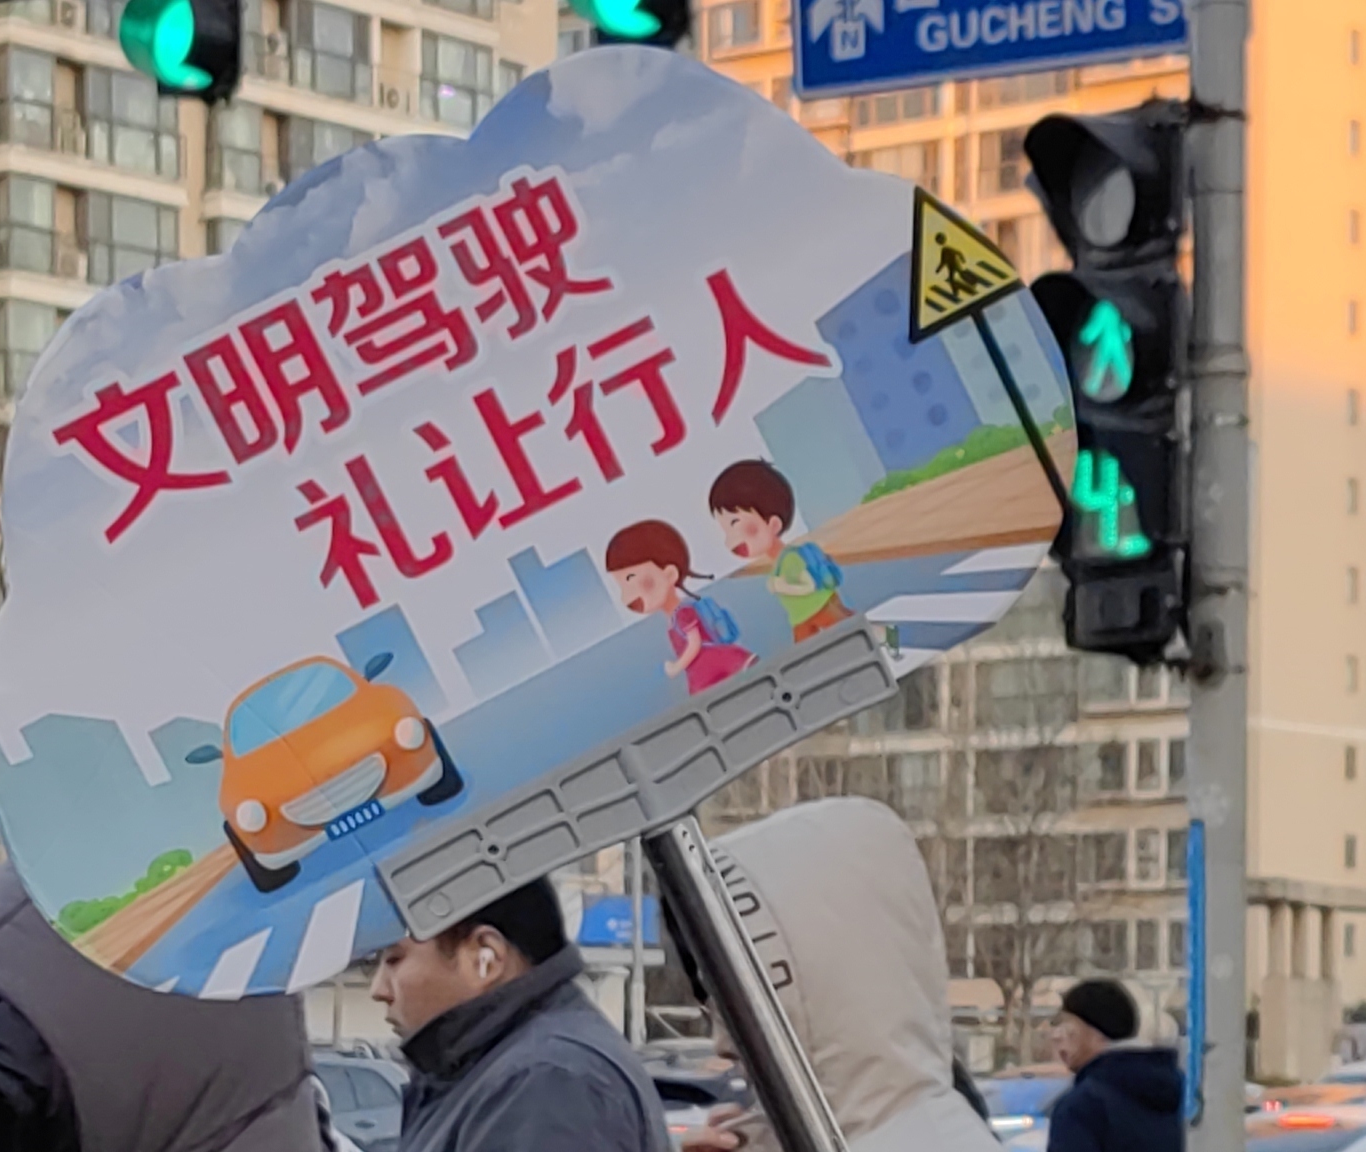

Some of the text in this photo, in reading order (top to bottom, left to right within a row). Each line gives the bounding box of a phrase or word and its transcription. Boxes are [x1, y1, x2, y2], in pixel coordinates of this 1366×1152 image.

[916, 0, 1193, 53] GUCHENG S
[52, 176, 613, 544] 文明驾驶
[293, 267, 832, 609] 礼让行人
